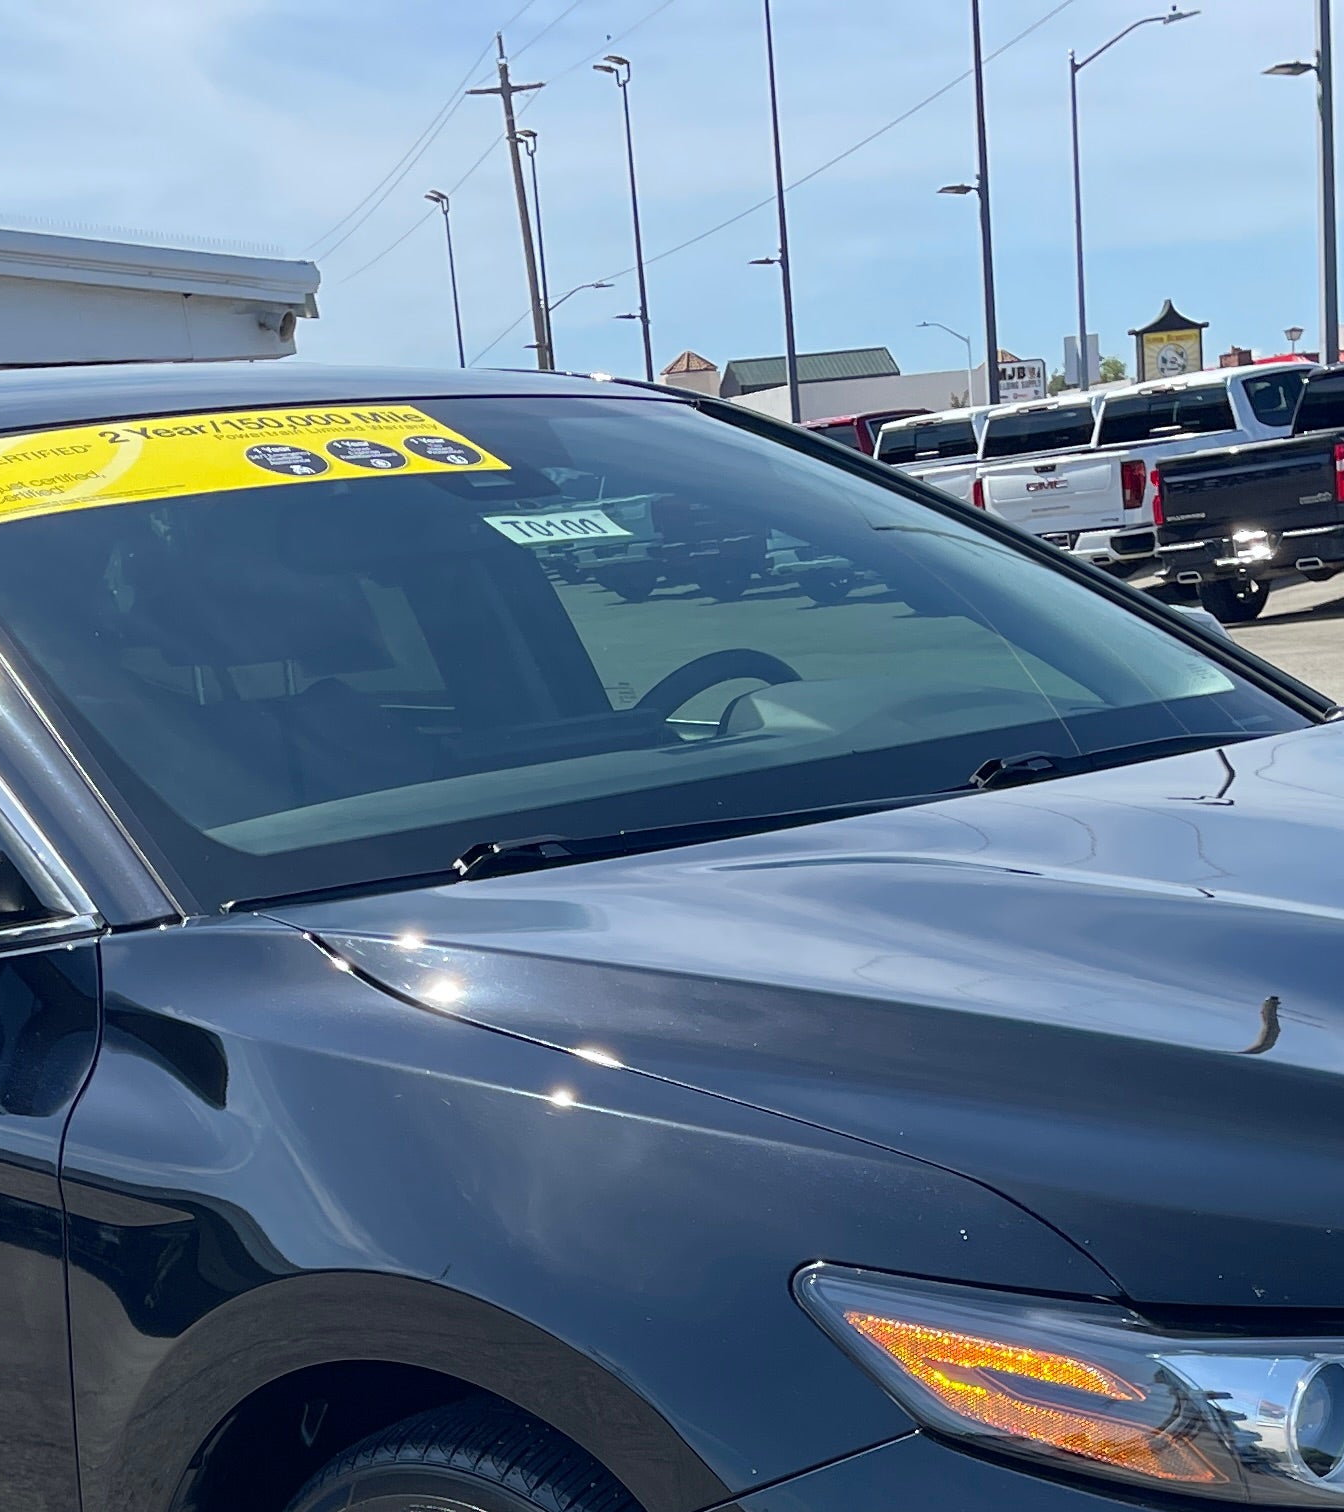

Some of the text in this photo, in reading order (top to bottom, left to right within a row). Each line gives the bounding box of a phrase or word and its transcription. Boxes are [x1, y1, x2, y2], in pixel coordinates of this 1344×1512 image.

[98, 430, 129, 444] 2
[354, 411, 426, 425] Mile
[213, 427, 304, 441] Powertrain
[306, 424, 365, 434] Limited
[1025, 480, 1068, 492] GMC
